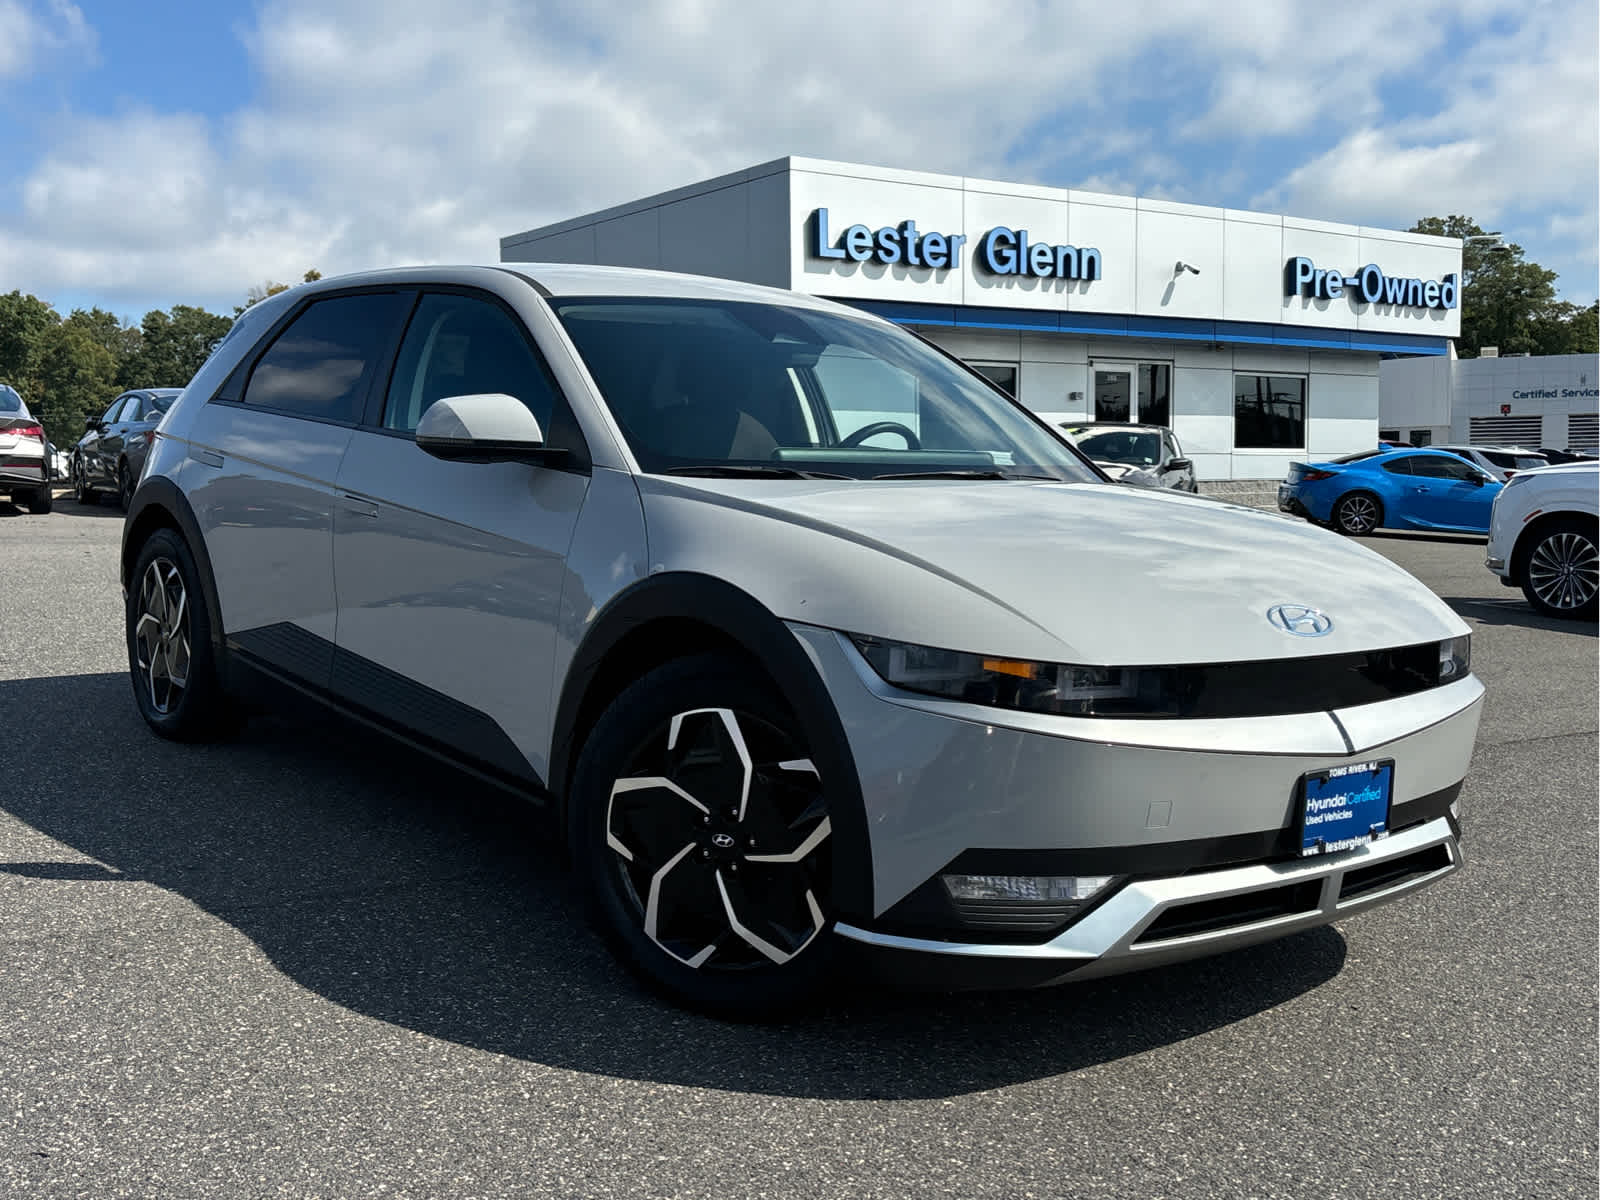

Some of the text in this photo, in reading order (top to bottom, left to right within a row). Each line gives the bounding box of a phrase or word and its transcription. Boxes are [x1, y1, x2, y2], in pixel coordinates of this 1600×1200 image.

[813, 207, 1102, 281] Lester Glenn
[1290, 256, 1458, 309] Pre-Owned
[1512, 389, 1558, 399] Certified
[1329, 767, 1348, 778] TOMS
[1306, 786, 1381, 813] Hyundai Certified
[1305, 810, 1353, 826] Used Vehicles
